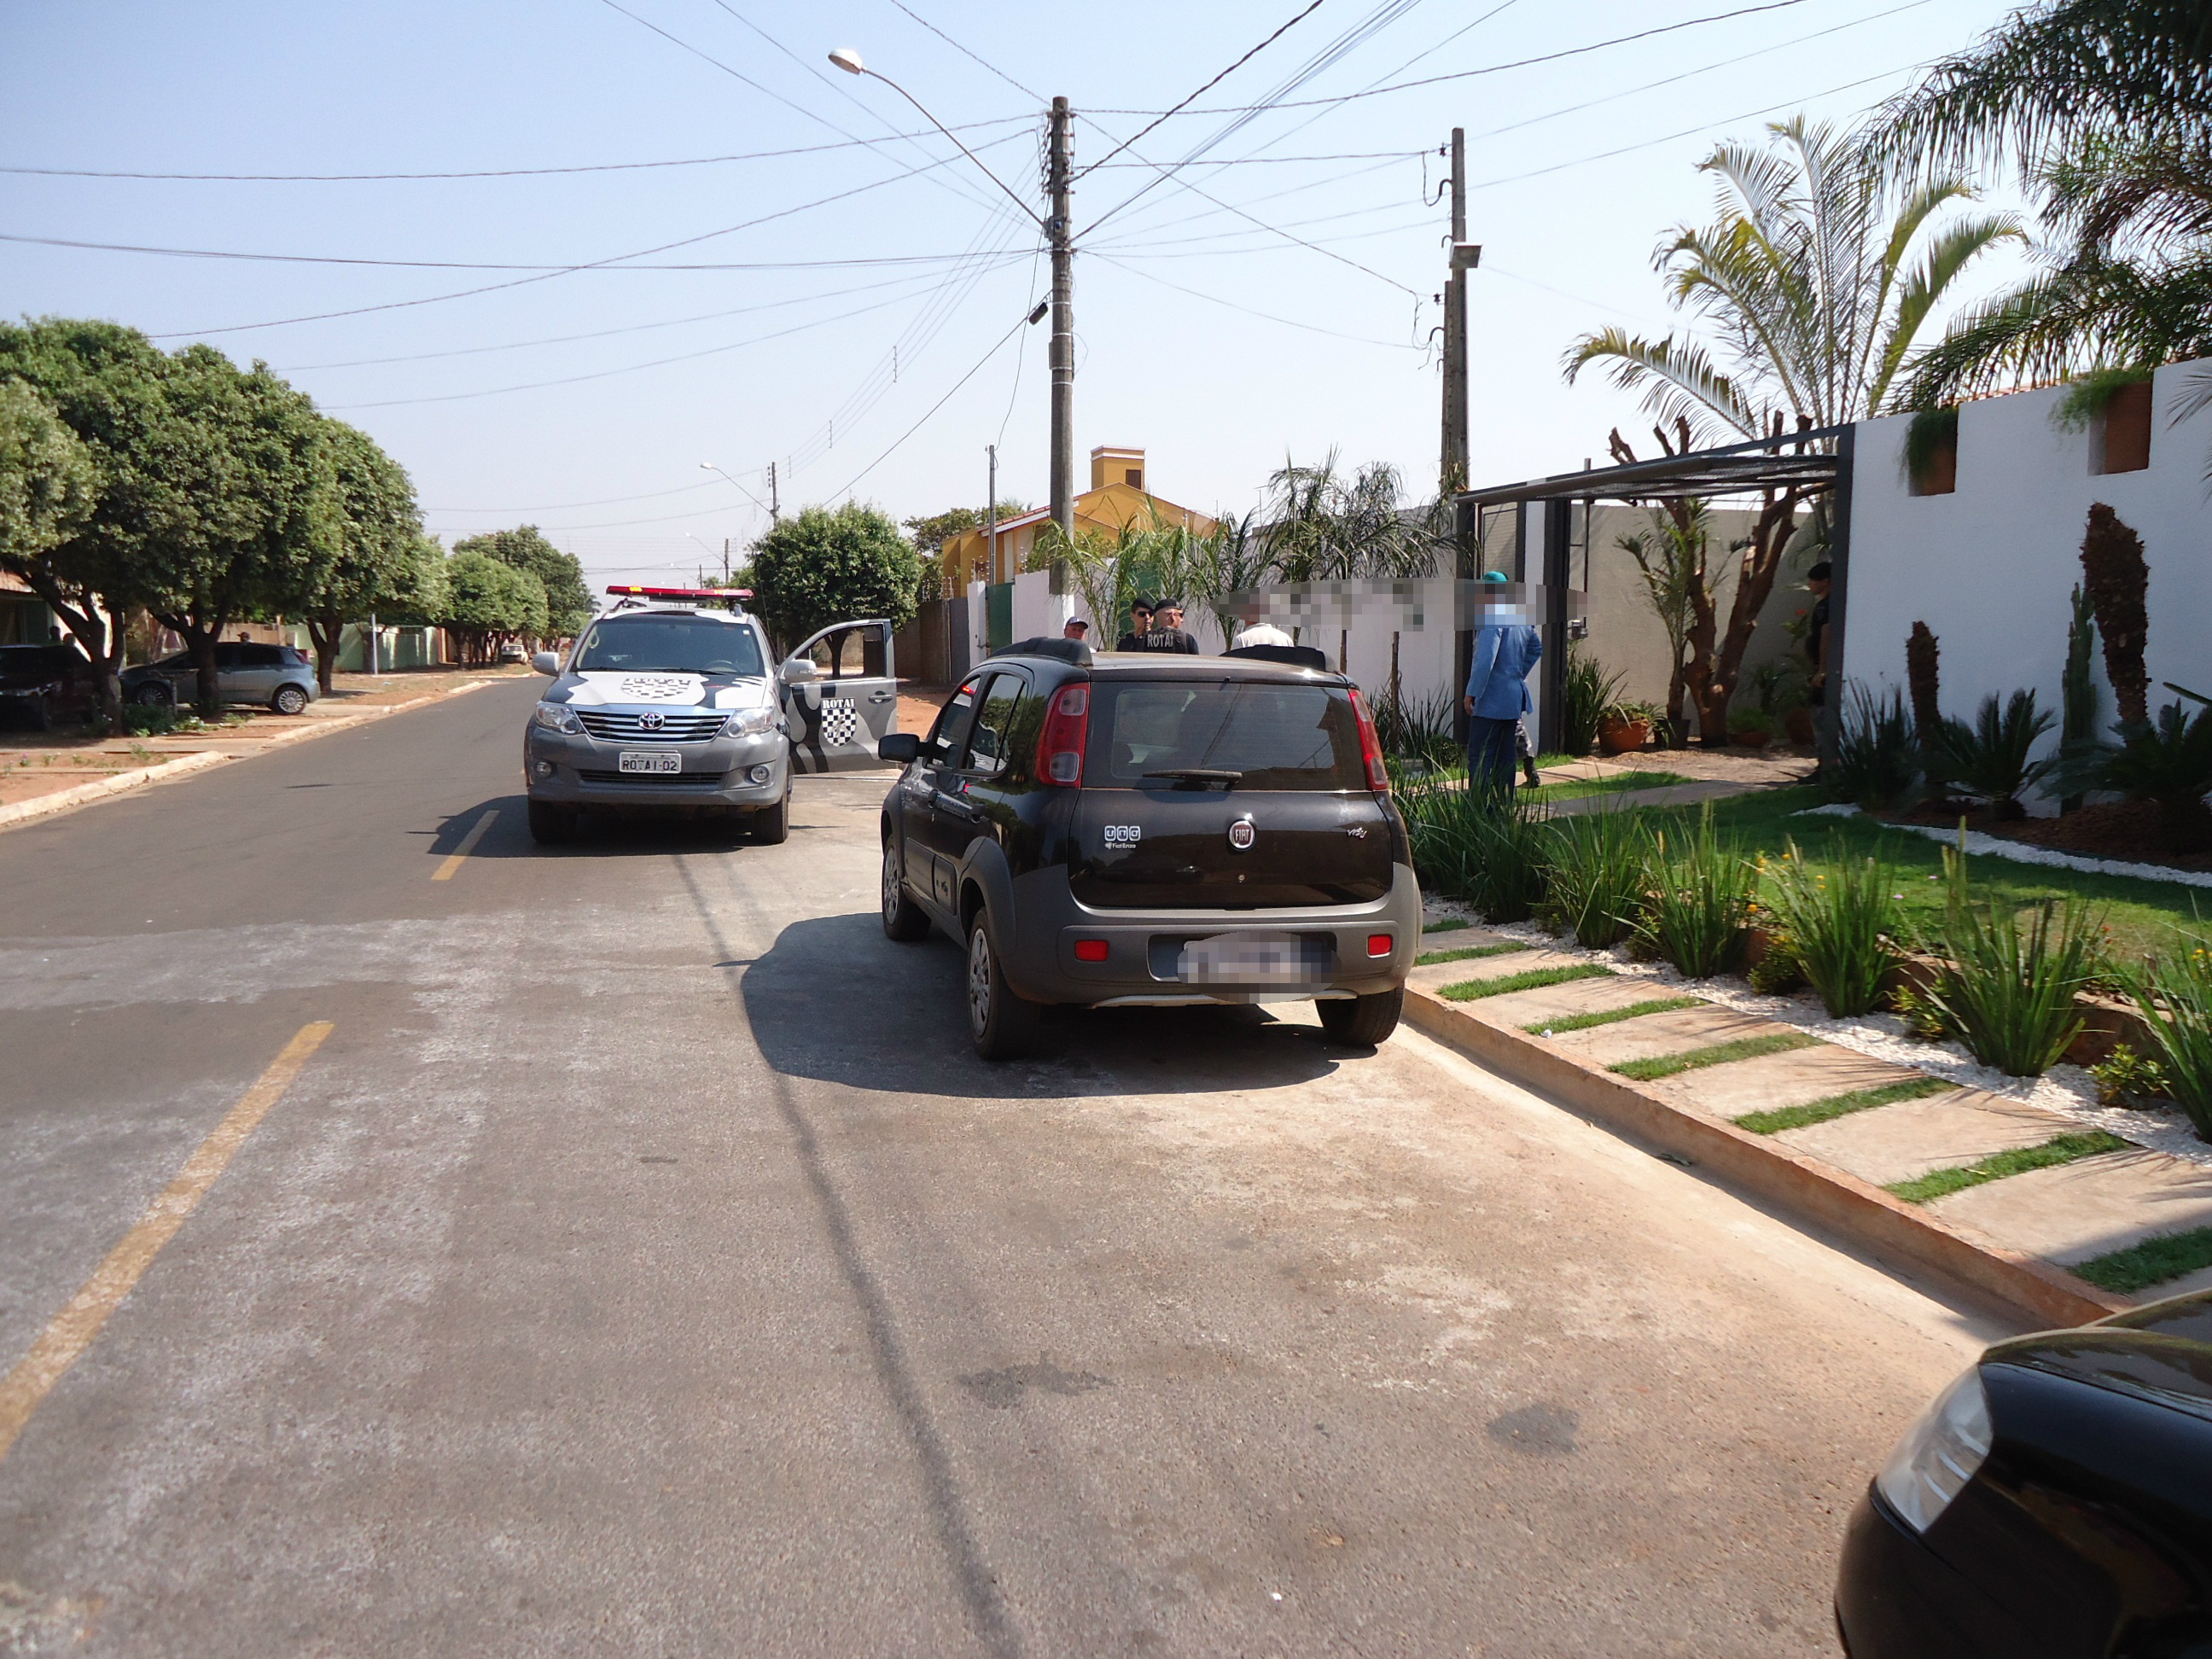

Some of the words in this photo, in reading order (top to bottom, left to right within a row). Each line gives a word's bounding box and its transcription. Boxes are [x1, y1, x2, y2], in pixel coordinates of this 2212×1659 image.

[1147, 632, 1173, 648] ROTAI
[822, 698, 855, 709] ROTAI
[1235, 829, 1250, 841] FIAT
